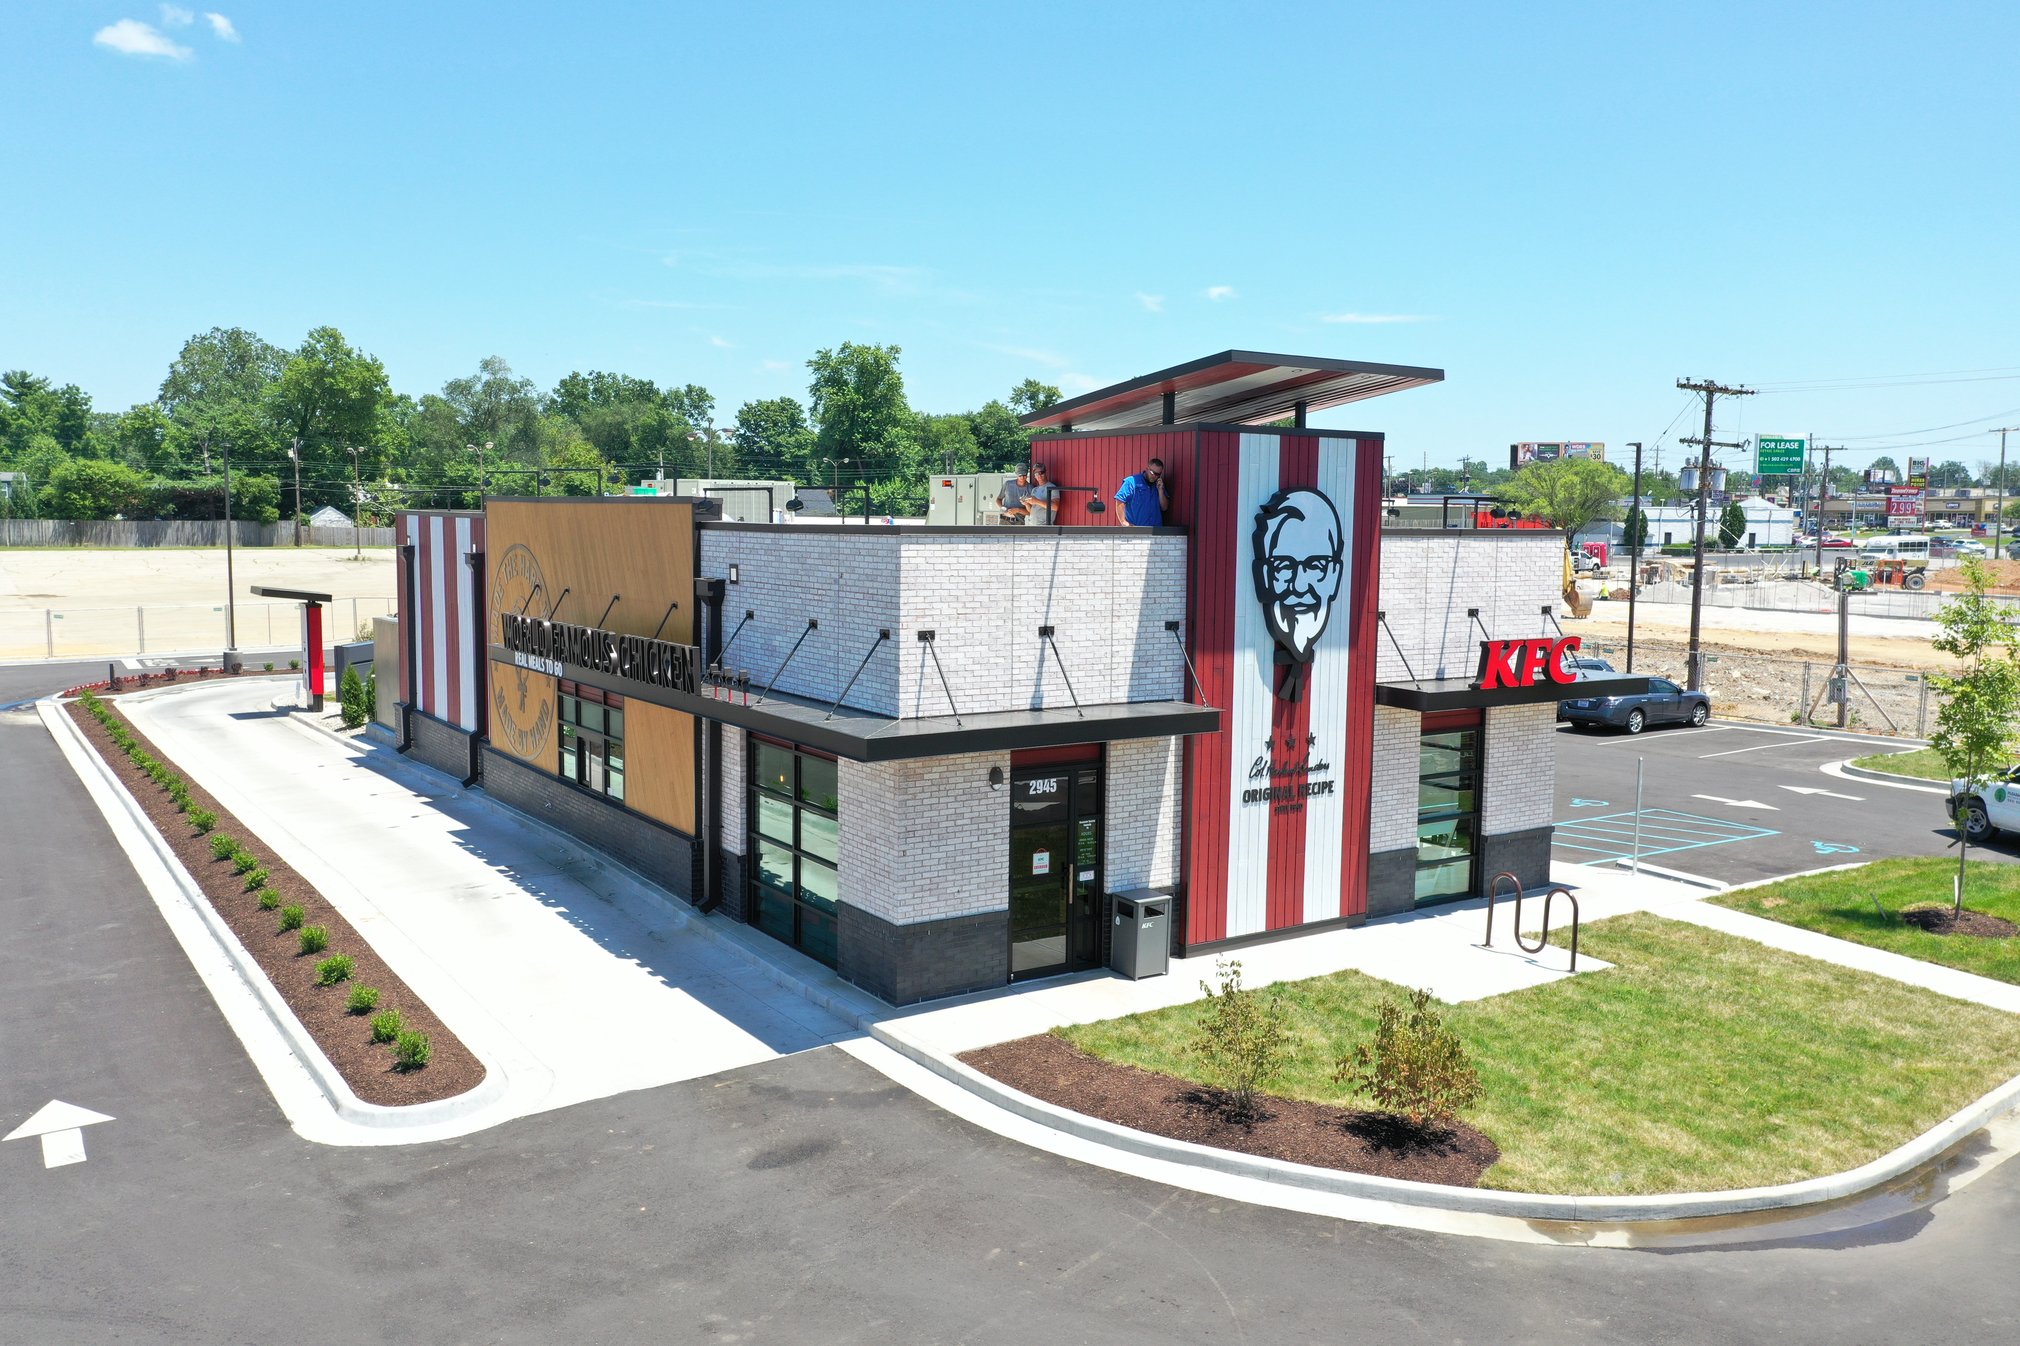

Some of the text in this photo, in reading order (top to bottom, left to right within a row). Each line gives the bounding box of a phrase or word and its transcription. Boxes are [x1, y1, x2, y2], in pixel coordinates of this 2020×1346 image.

[1760, 441, 1799, 449] FOR LEASE
[501, 612, 698, 695] WORLD FAMOUS CHICKEN
[514, 651, 563, 677] REAL MEALS TO GO
[1479, 635, 1582, 690] KFC
[1029, 778, 1058, 796] 2945
[1242, 780, 1335, 804] ORIGINAL RECIPE
[1141, 921, 1155, 929] KFC
